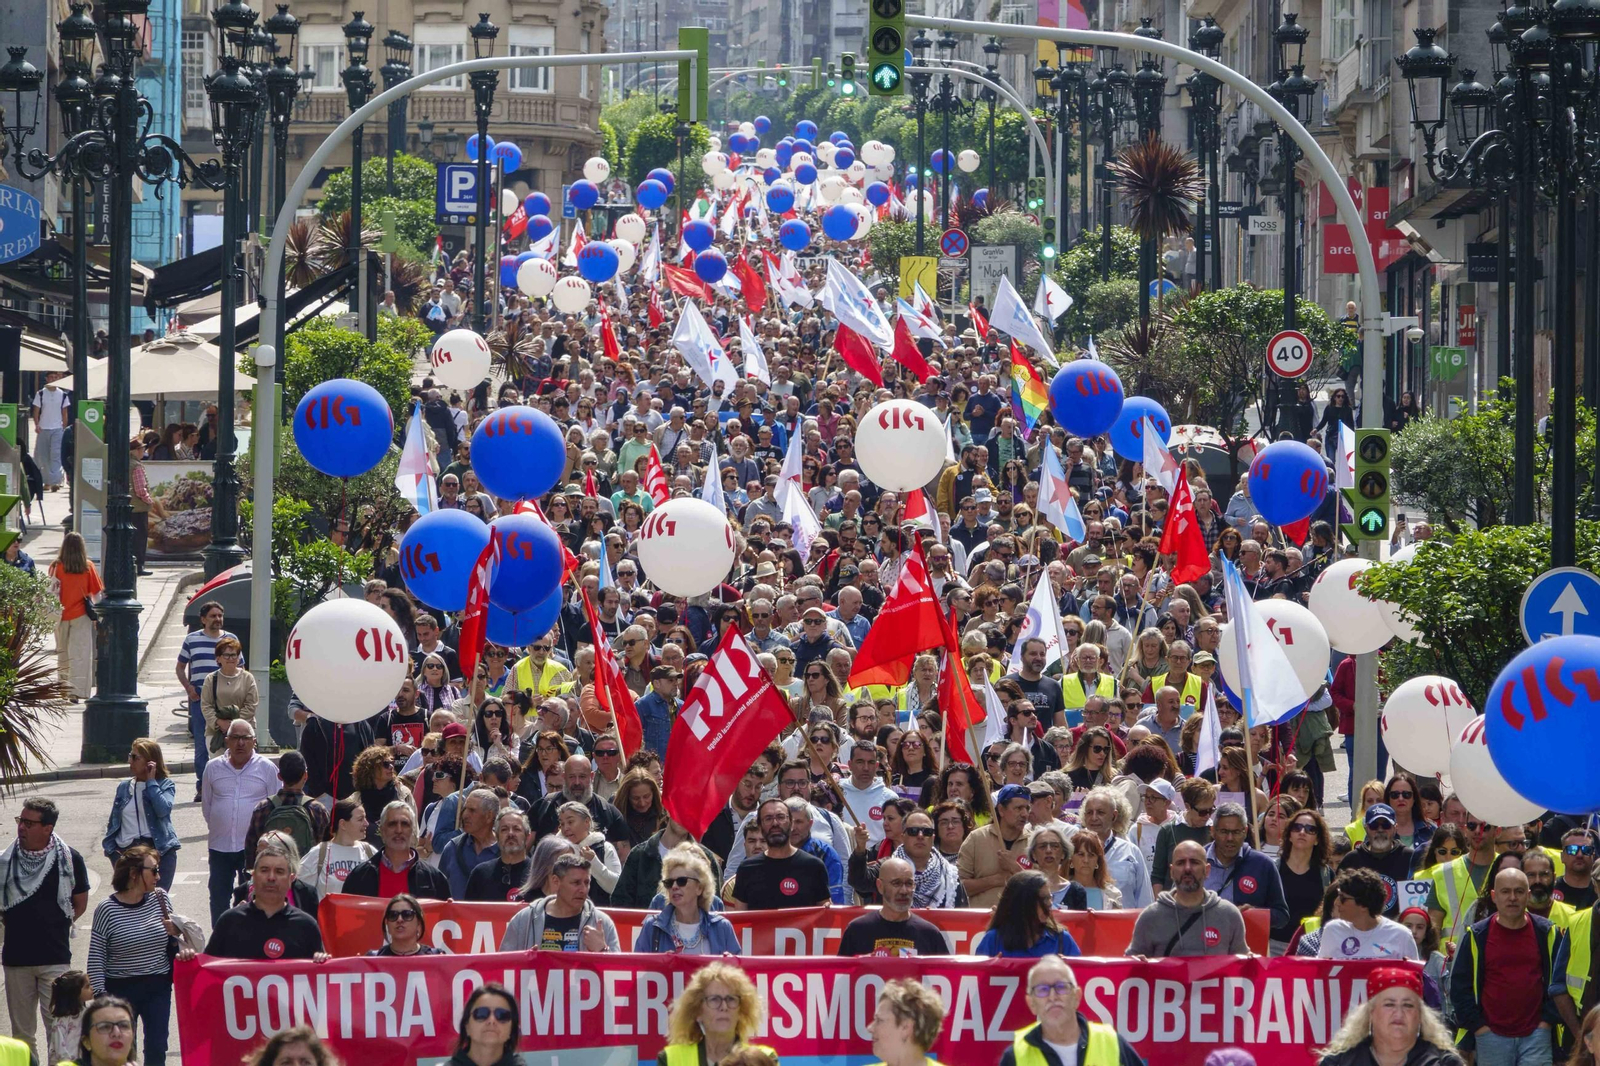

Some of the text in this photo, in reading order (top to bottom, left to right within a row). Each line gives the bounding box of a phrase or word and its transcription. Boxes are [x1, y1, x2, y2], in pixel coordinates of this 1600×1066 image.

[452, 171, 475, 199] P
[102, 162, 110, 243] AETERIA
[1253, 219, 1277, 229] hoss
[1276, 345, 1304, 362] 40
[1076, 371, 1118, 396] CIG
[305, 395, 361, 430] CIG
[485, 412, 532, 438] CIG
[878, 407, 924, 431] CIG
[640, 512, 677, 541] CIG
[493, 531, 533, 567] IG
[355, 628, 404, 663] CIG
[1424, 683, 1473, 709] CIG
[1501, 656, 1600, 732] CIG
[223, 970, 436, 1041] CONTRA
[503, 968, 885, 1041] IMPERIISMO
